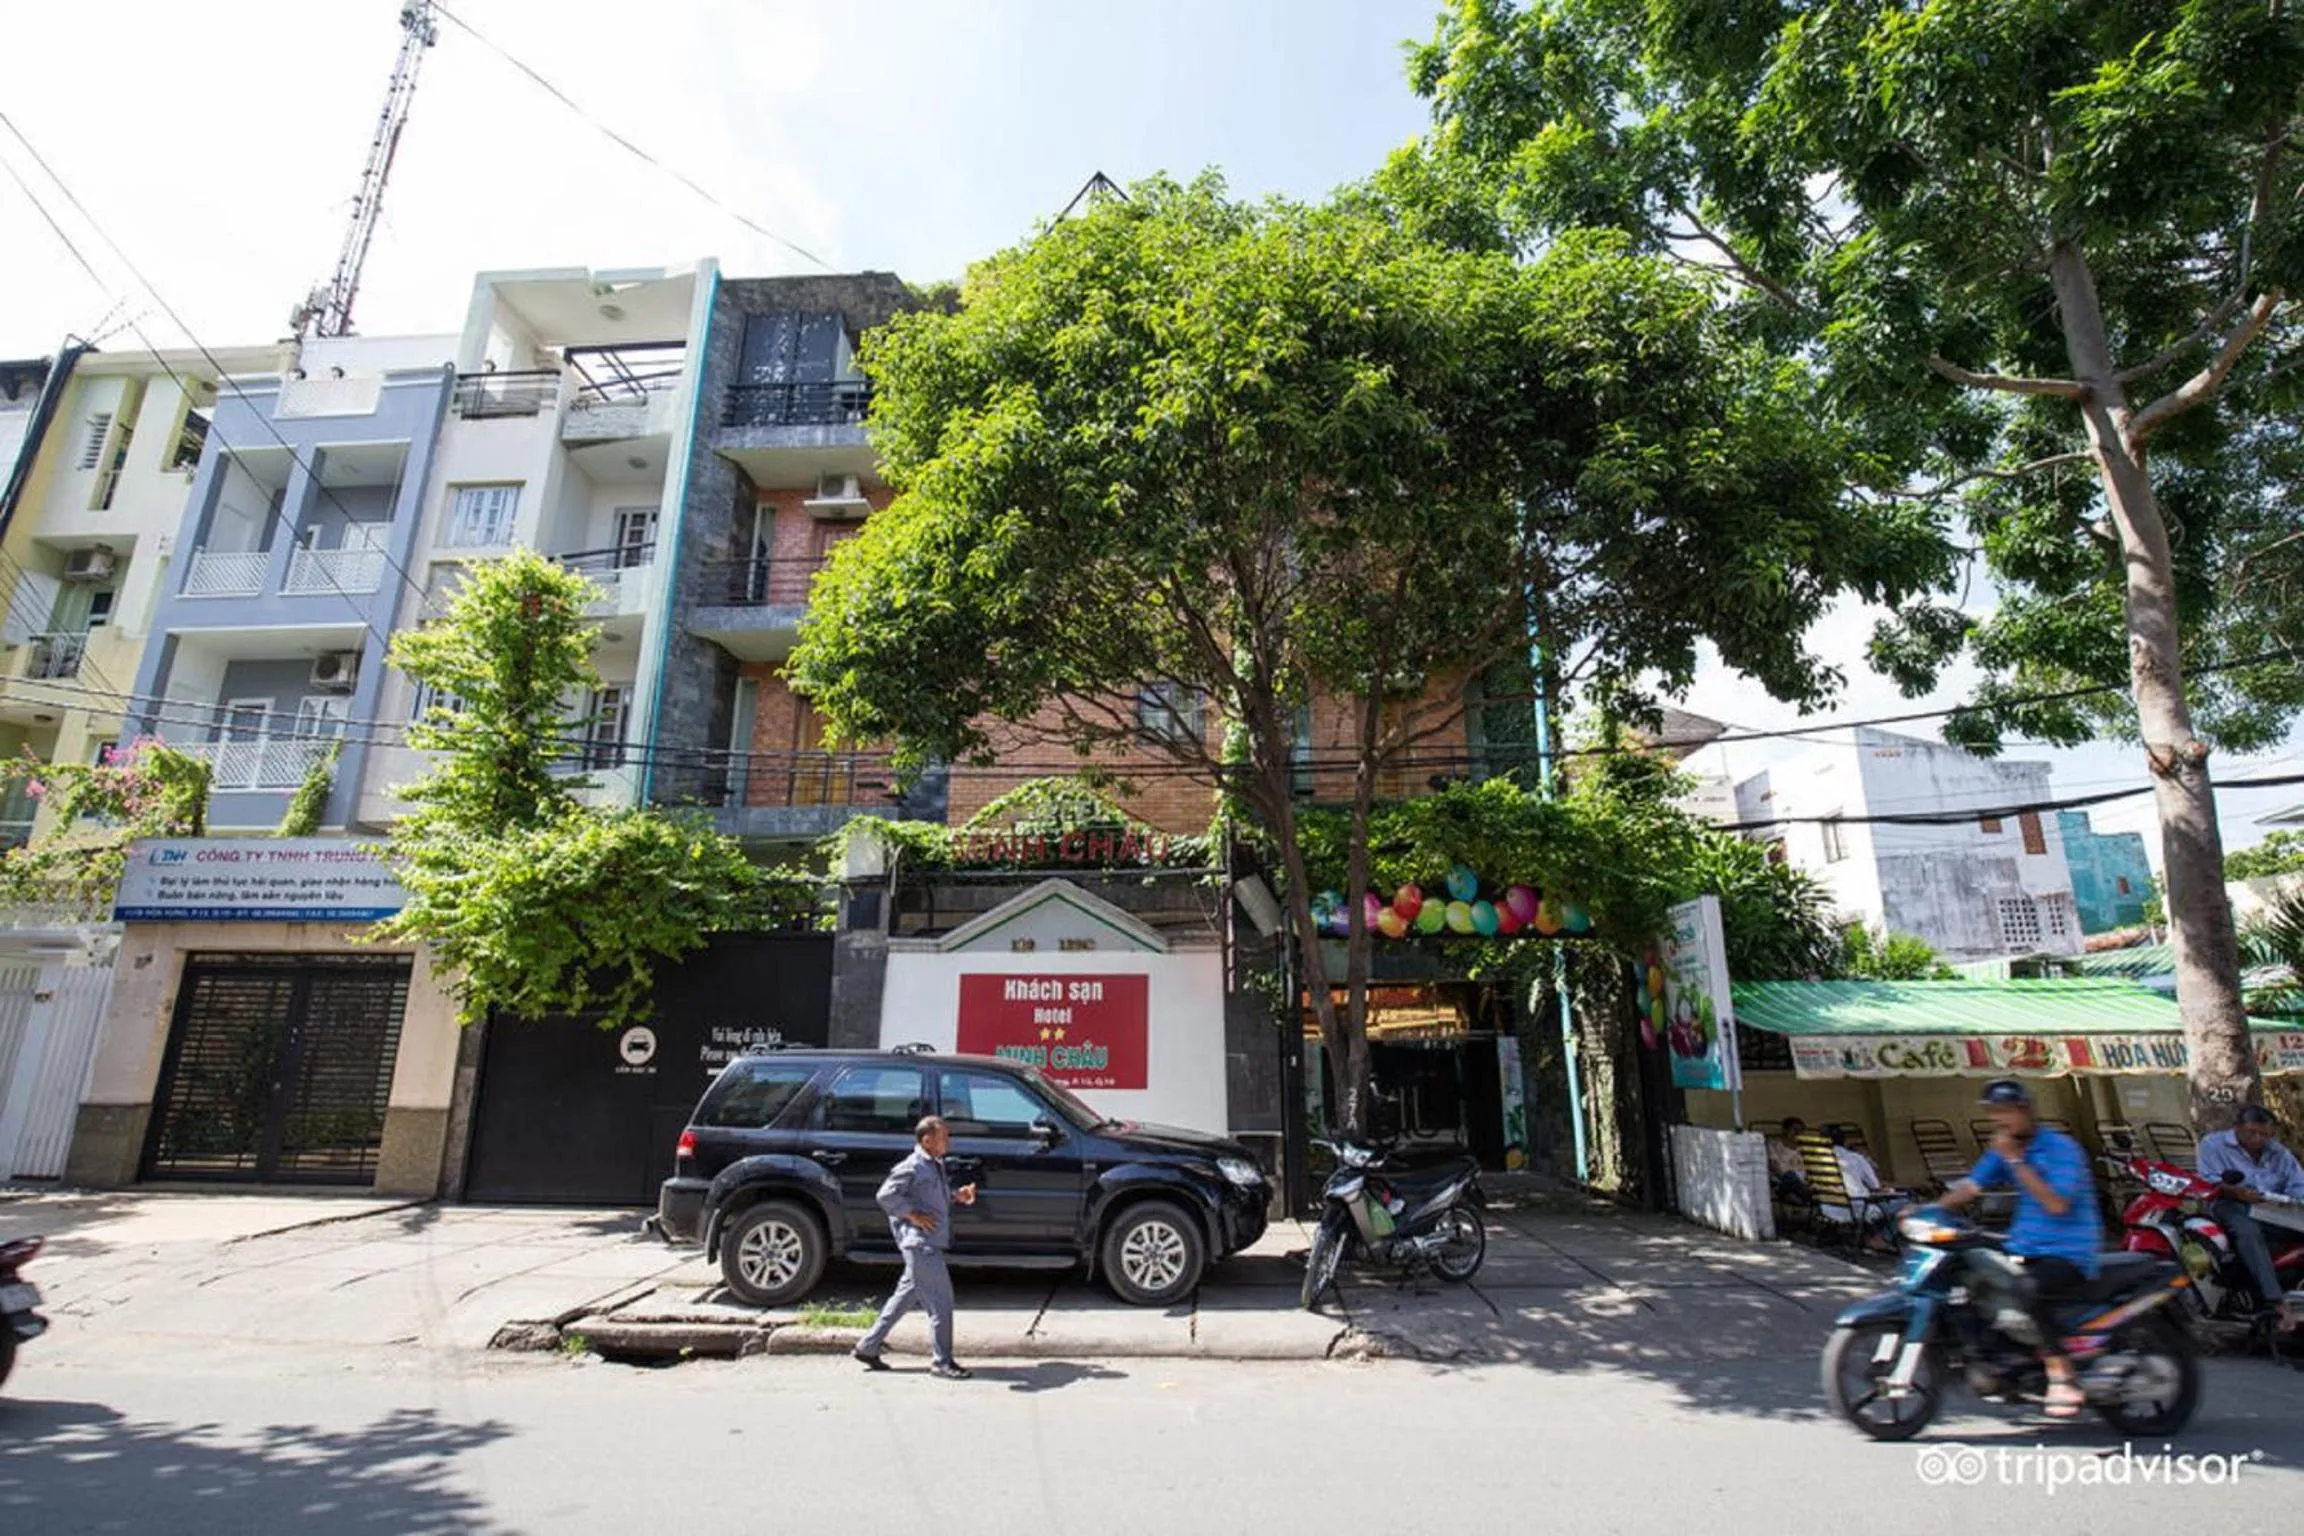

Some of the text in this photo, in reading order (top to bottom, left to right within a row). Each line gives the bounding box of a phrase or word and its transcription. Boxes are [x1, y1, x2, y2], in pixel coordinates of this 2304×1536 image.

[246, 850, 264, 862] TY
[1005, 978, 1103, 1005] Khách sạn
[1034, 1007, 1072, 1024] Hotel
[1050, 1040, 1108, 1070] CHÂU
[1877, 1040, 1955, 1070] Café
[2100, 1036, 2151, 1068] HÒA
